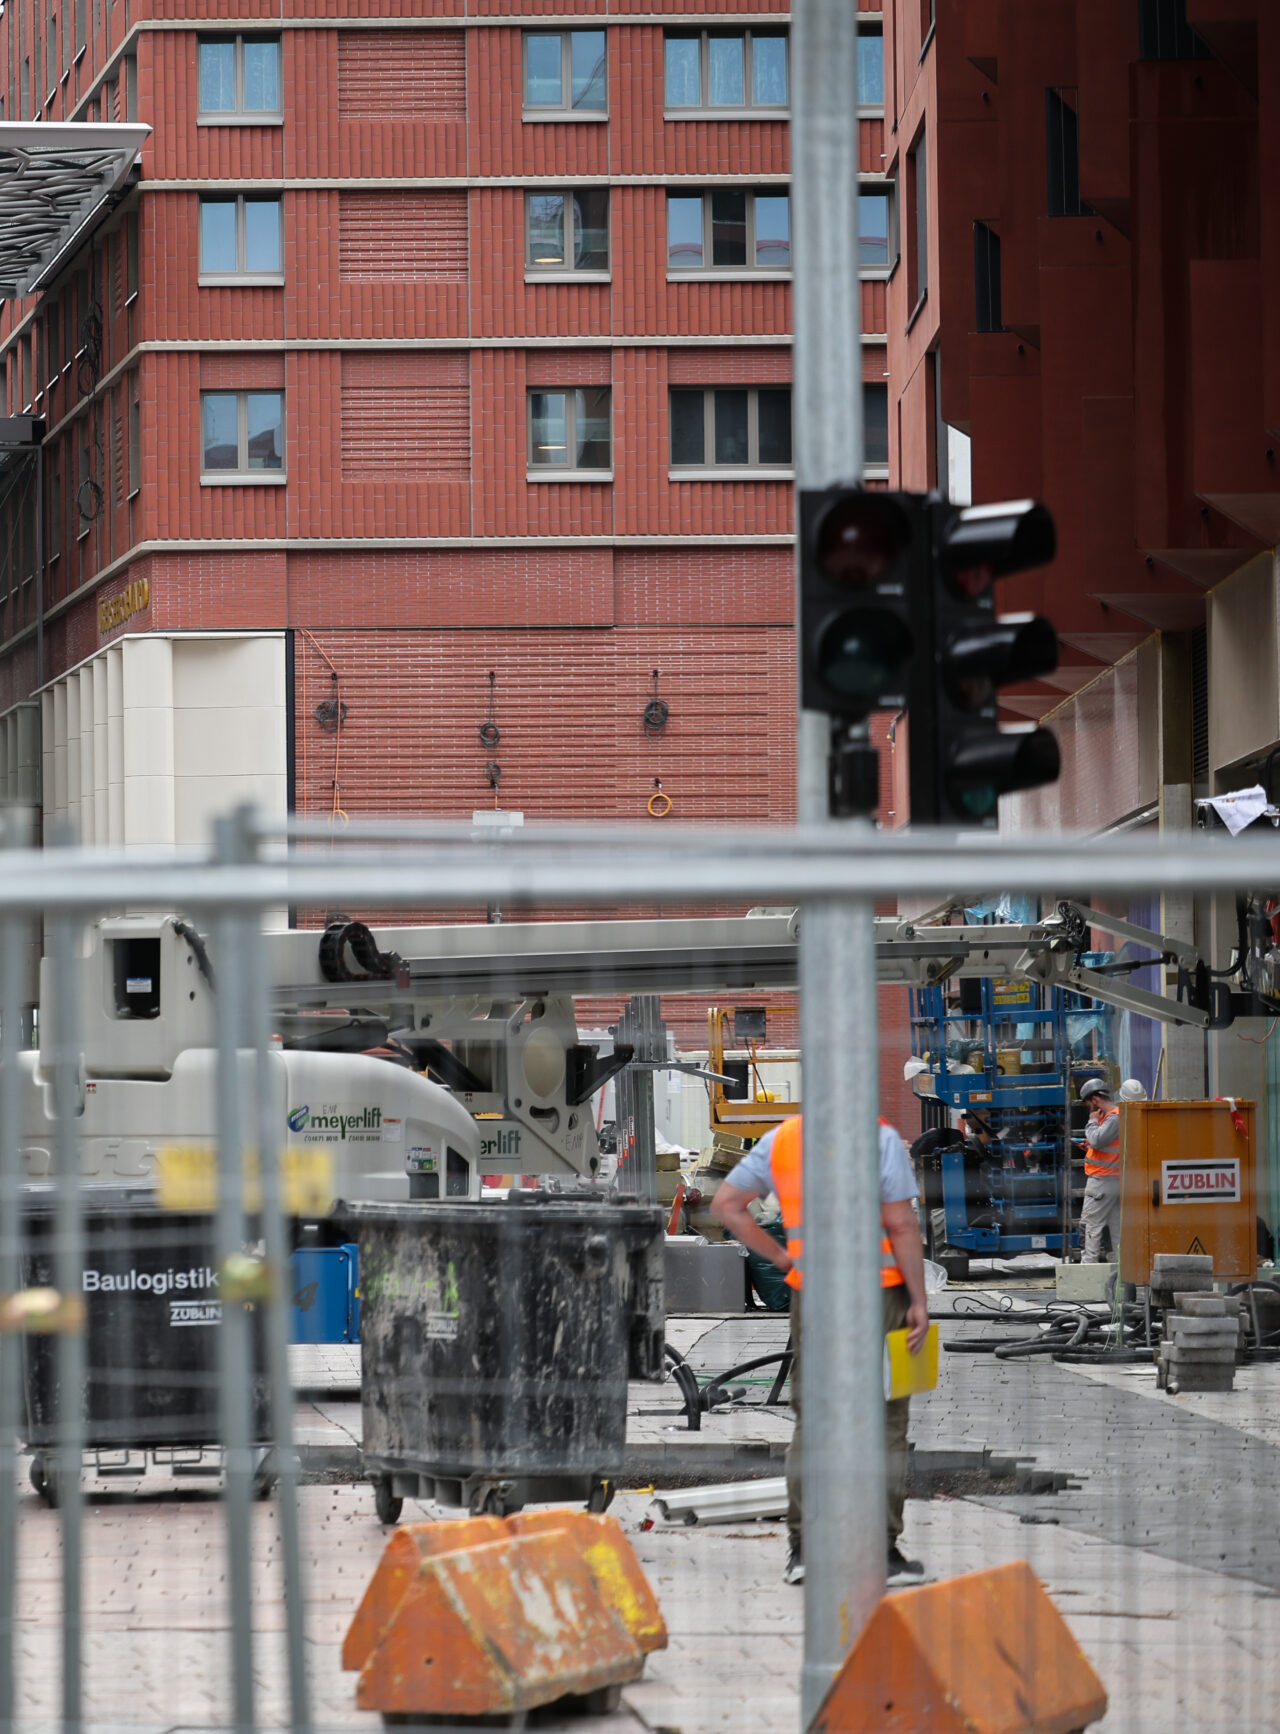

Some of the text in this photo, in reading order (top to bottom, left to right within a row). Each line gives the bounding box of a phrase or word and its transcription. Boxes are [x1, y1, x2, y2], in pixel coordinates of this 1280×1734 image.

[311, 1107, 382, 1140] meyerlift
[1167, 1172, 1236, 1191] ZÜBLIN
[82, 1268, 220, 1294] Baulogistik
